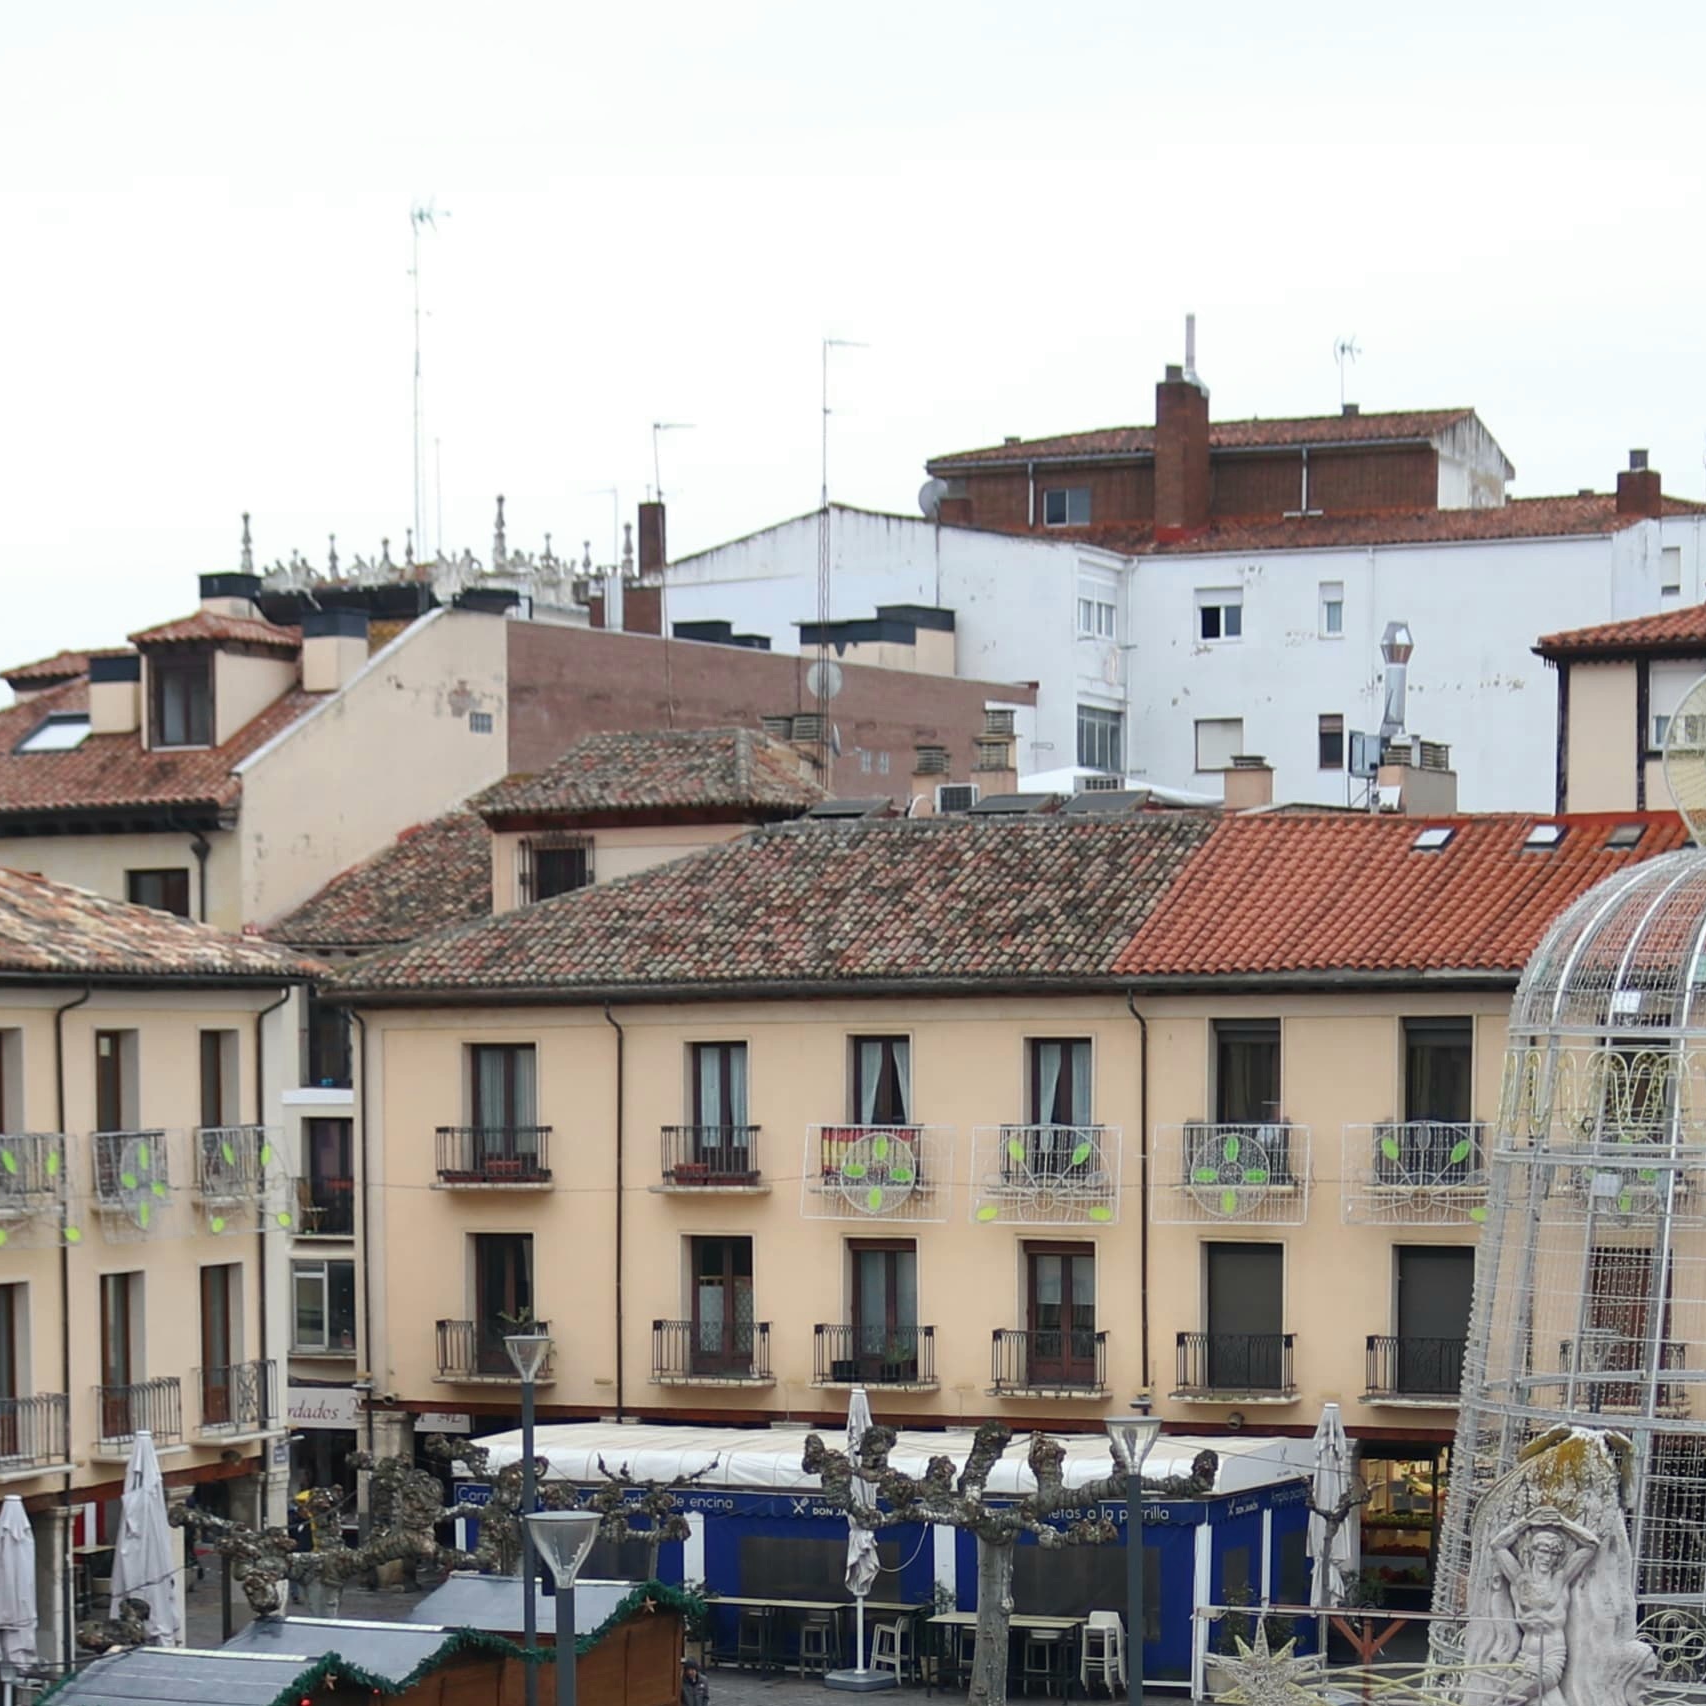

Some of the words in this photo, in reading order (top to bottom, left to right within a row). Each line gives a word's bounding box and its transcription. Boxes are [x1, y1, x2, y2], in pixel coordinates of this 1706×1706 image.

[690, 1495, 733, 1510] encina
[813, 1507, 833, 1516] DON
[1087, 1511, 1096, 1520] a
[1101, 1505, 1114, 1520] la
